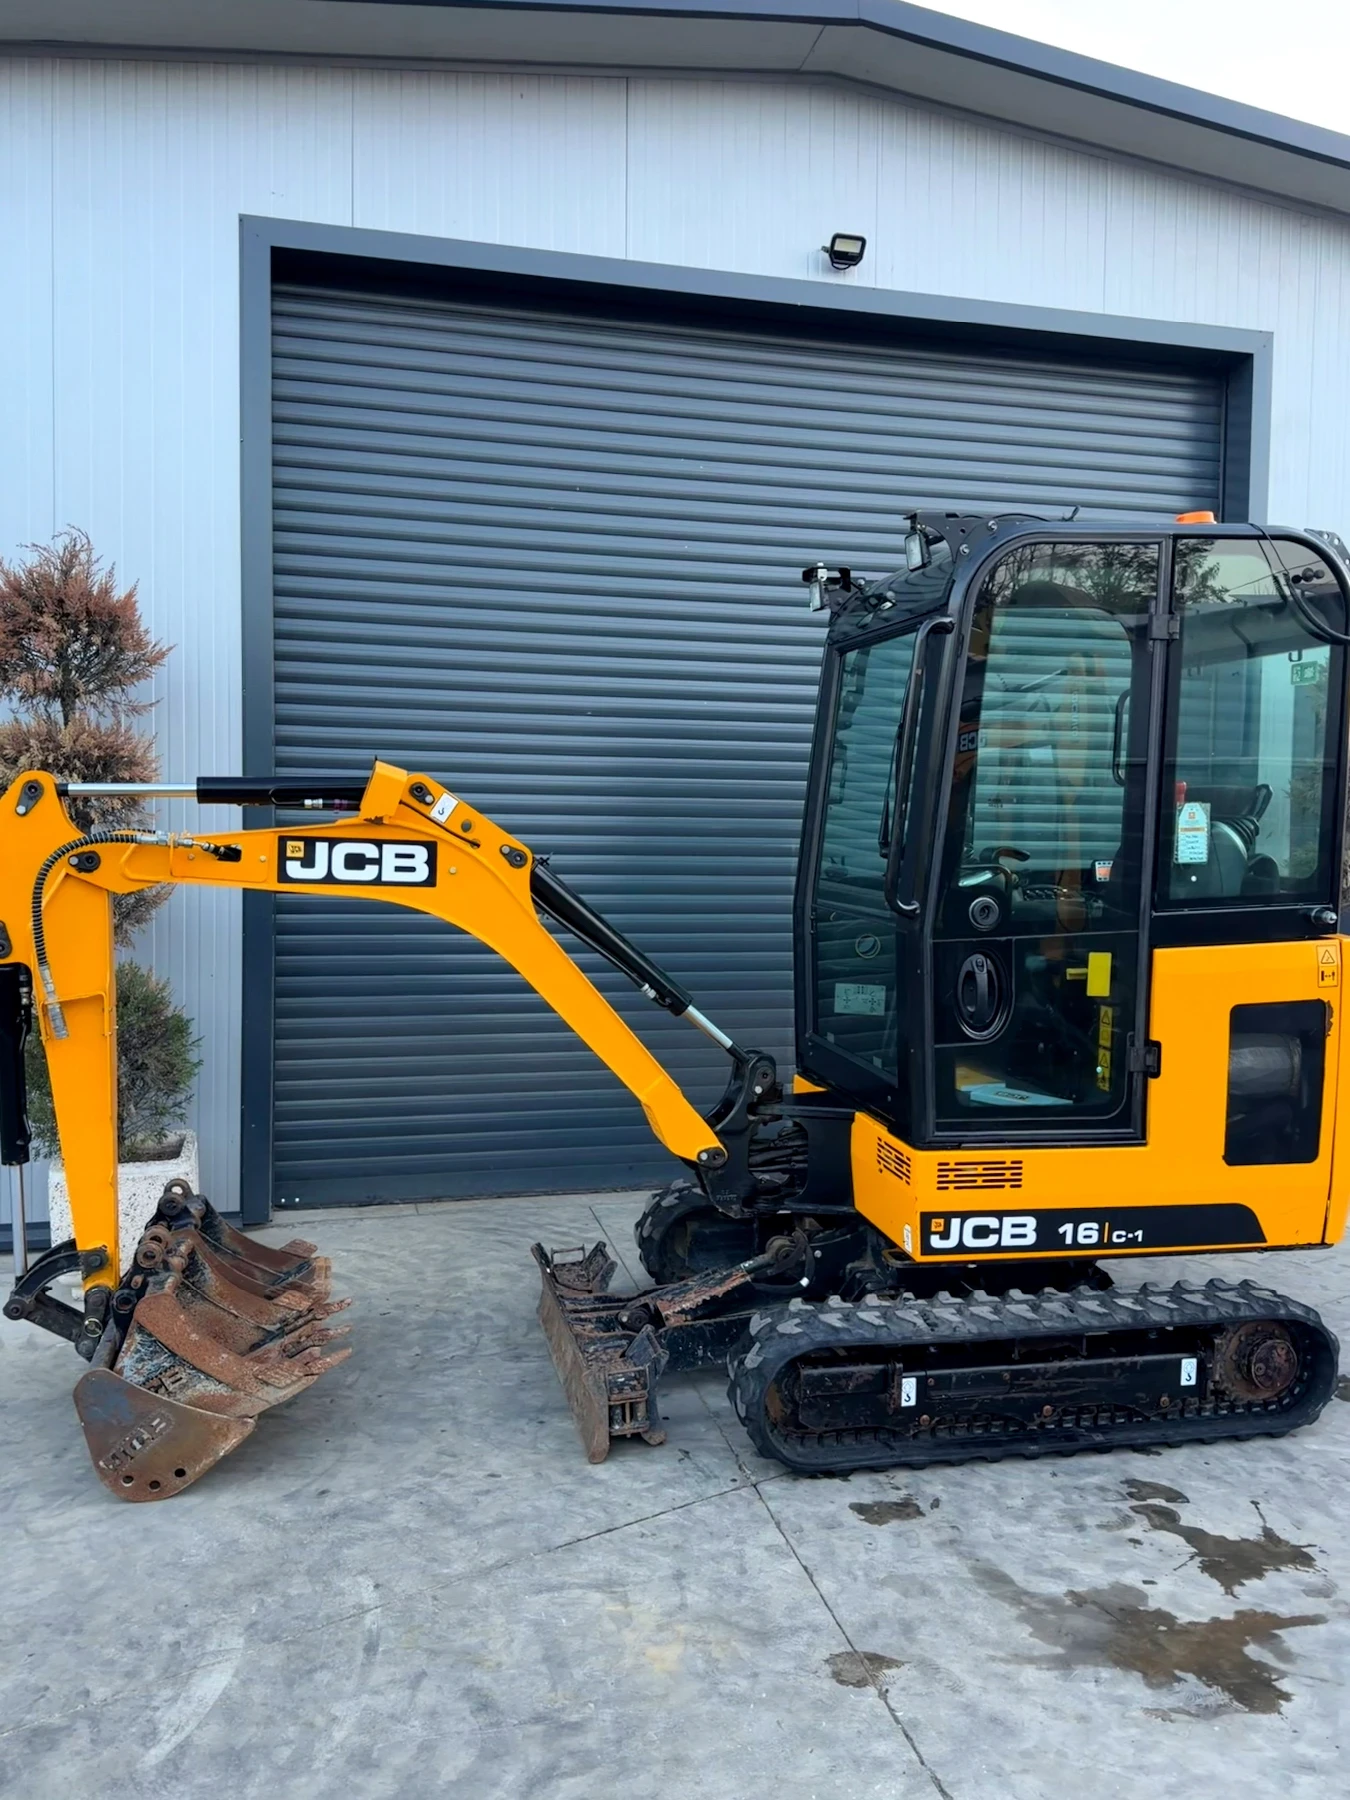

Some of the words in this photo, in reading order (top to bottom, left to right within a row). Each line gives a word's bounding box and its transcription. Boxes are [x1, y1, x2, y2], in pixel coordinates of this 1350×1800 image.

[286, 841, 429, 883] JCB
[930, 1215, 1037, 1249] JCB
[1058, 1222, 1100, 1245] 16
